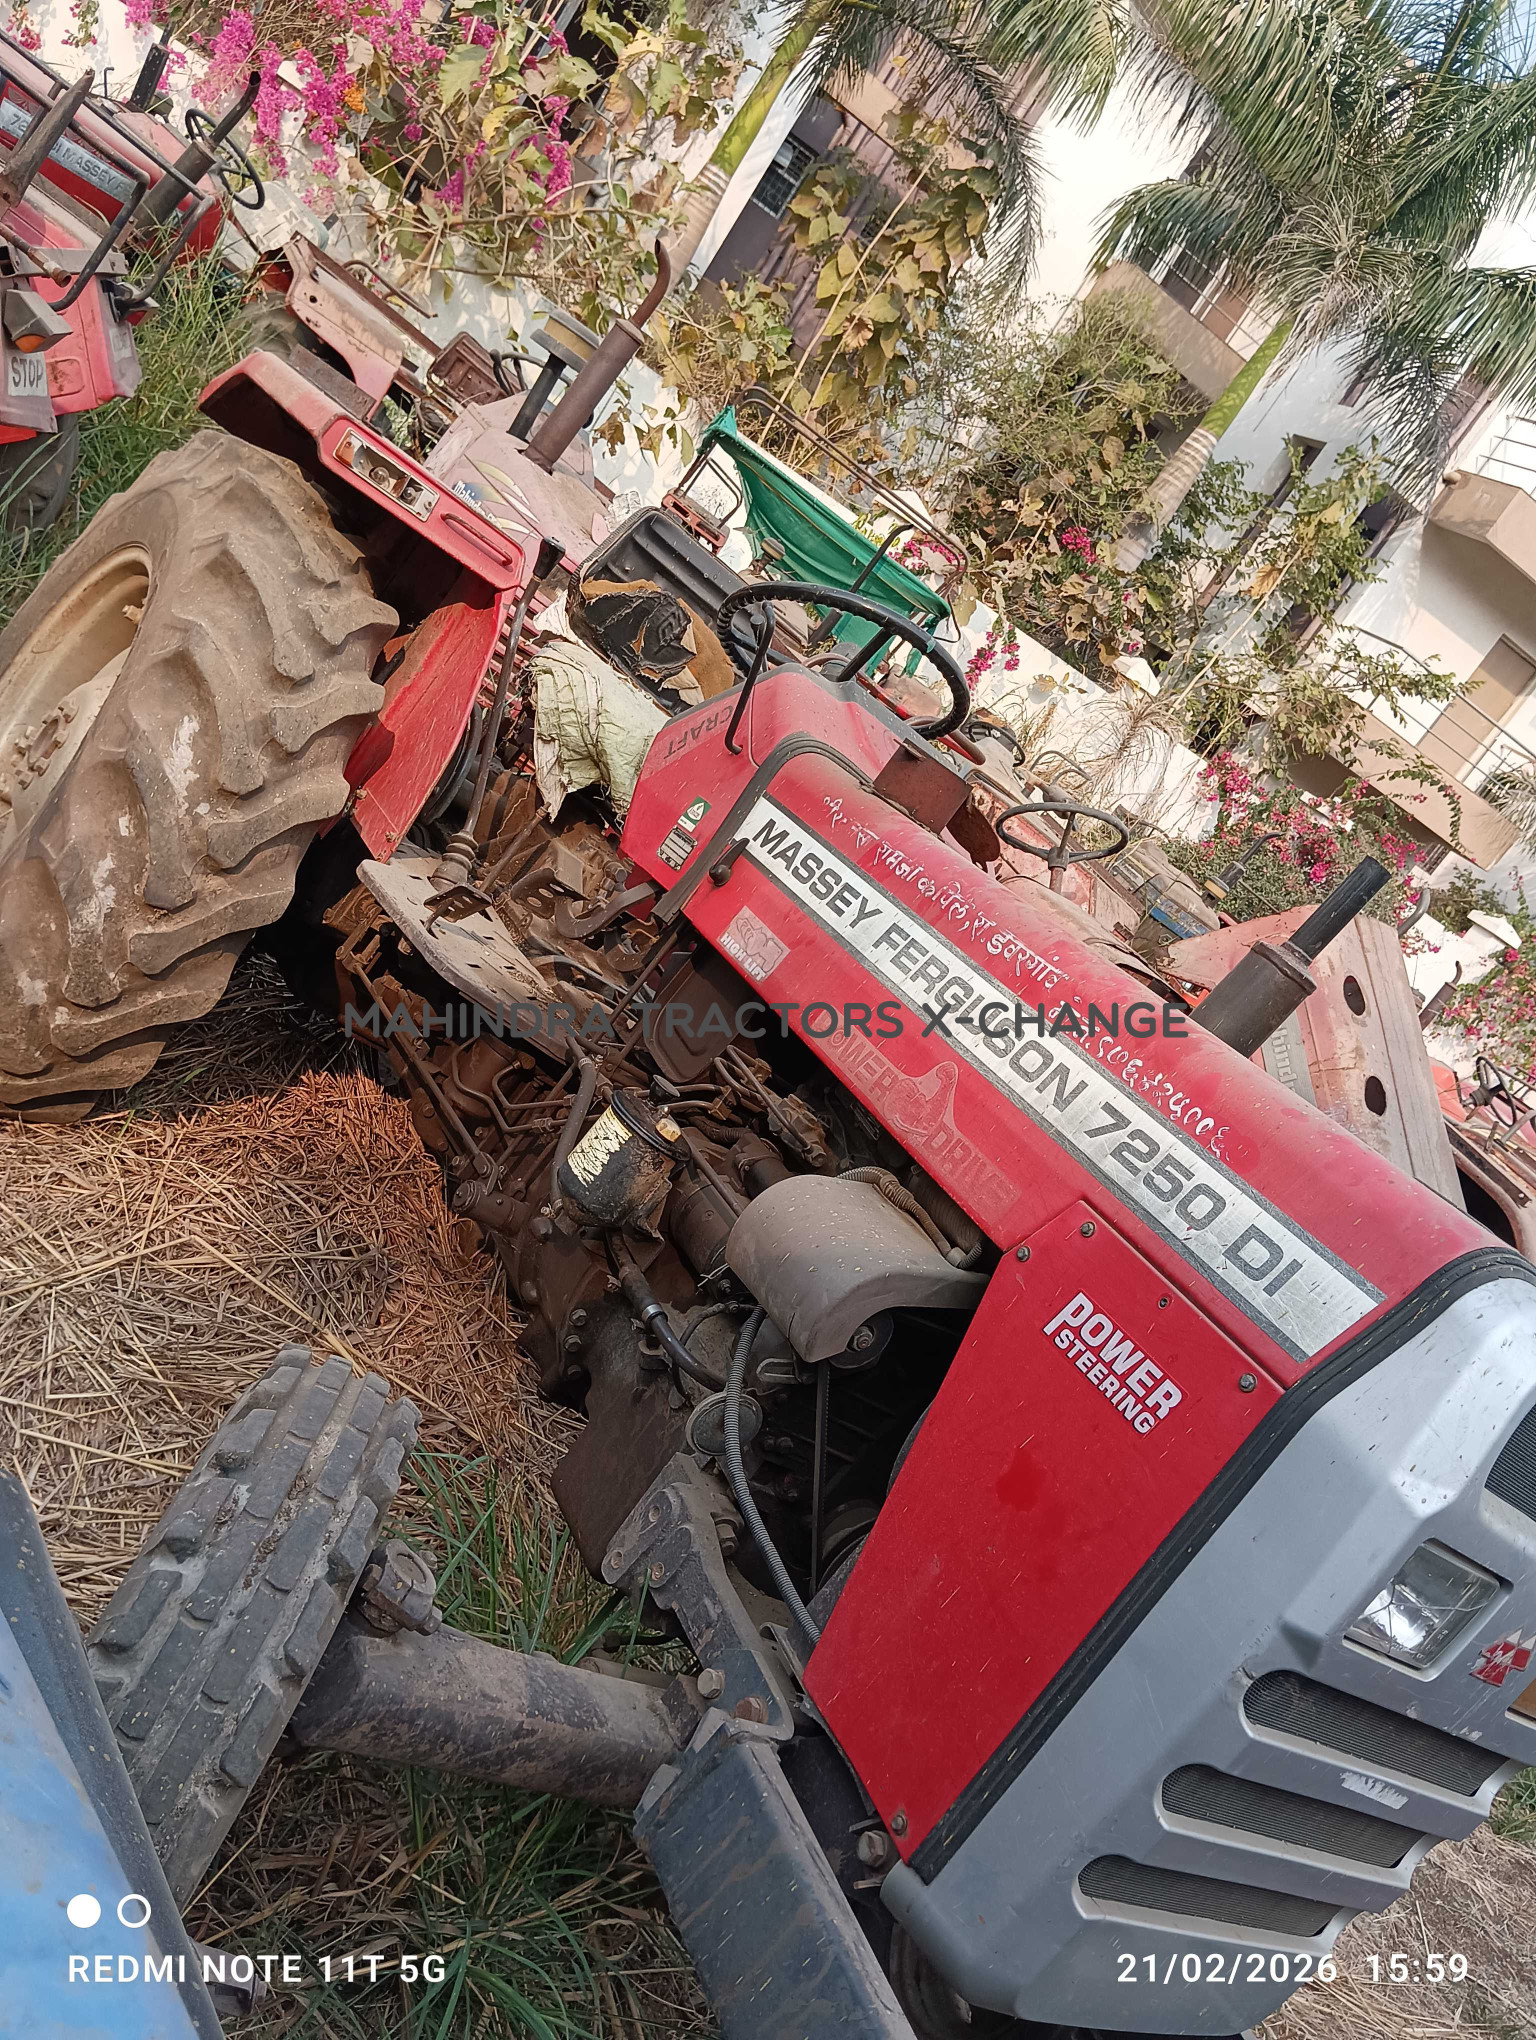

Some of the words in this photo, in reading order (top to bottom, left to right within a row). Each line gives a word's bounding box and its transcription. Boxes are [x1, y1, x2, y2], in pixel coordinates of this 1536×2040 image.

[62, 147, 116, 186] MASSEY
[11, 356, 44, 388] STOP
[663, 705, 734, 760] CRAFT
[720, 932, 748, 962] HIGH
[740, 958, 766, 981] LIFT
[752, 818, 883, 930] MASSEY
[872, 922, 1088, 1113] FERGUSON
[1084, 1101, 1227, 1232] 7250
[1222, 1223, 1304, 1298] DI
[820, 1019, 901, 1098] OWER
[1042, 1292, 1183, 1420] POWER
[1054, 1328, 1155, 1434] STEERING
